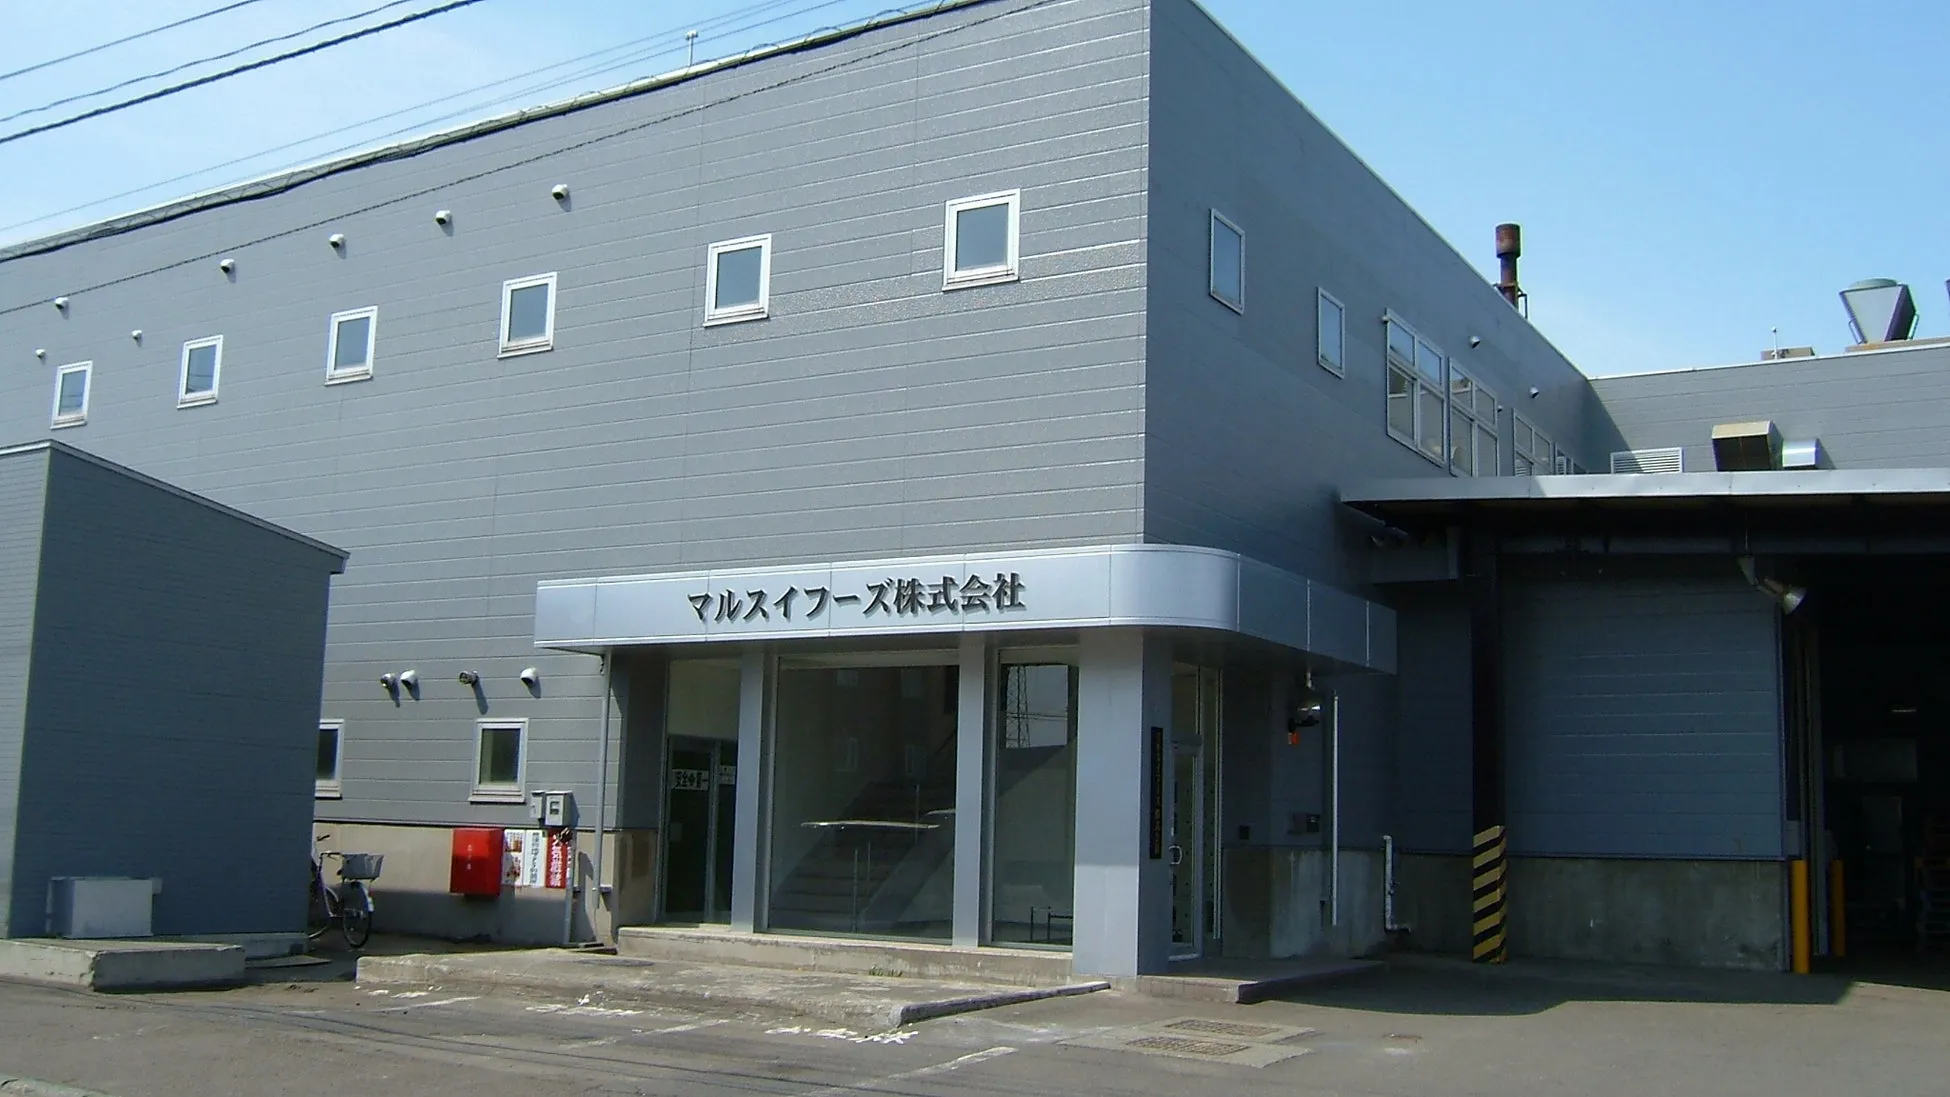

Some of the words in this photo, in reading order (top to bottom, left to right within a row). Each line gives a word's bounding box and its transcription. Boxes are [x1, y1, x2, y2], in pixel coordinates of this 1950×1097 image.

[687, 572, 1026, 623] マルスイフーズ株式会社
